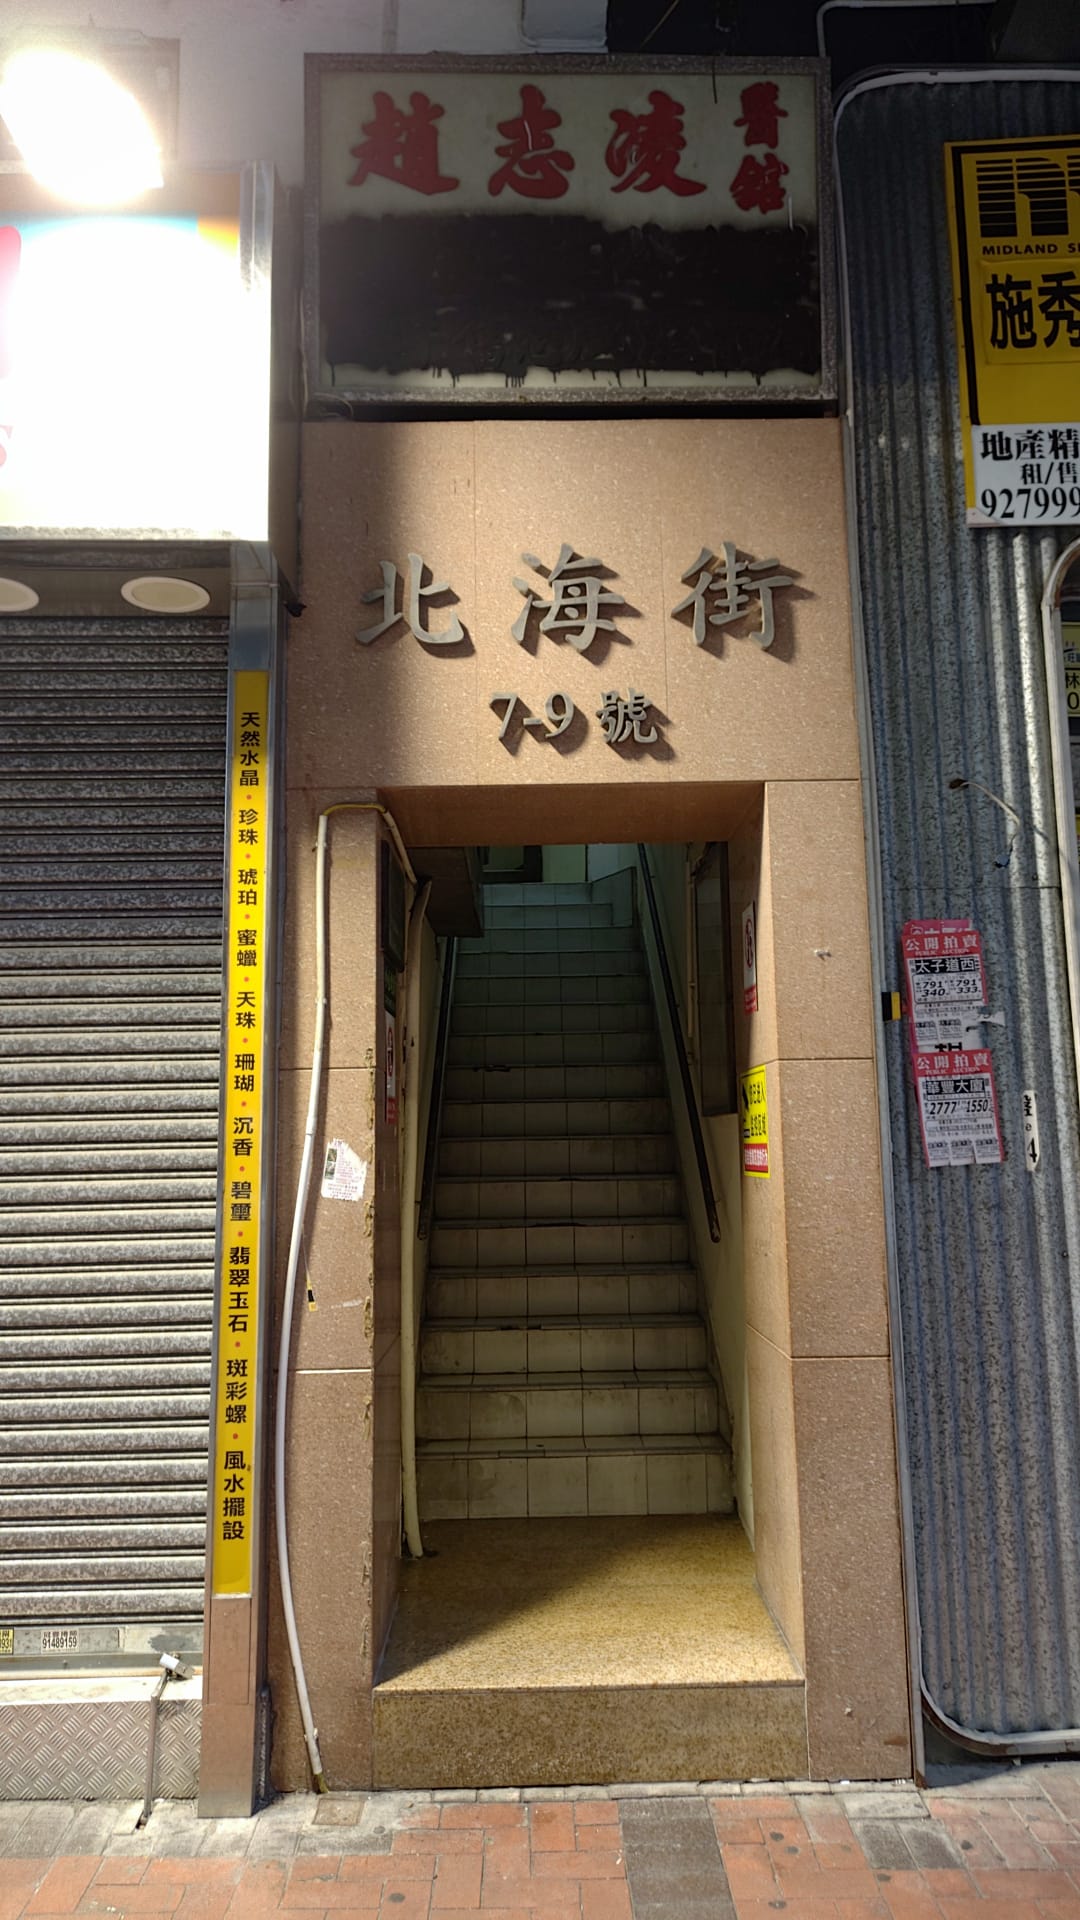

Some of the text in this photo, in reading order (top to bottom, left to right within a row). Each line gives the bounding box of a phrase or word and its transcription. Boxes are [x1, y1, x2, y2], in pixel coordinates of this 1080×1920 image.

[982, 243, 1058, 255] MIDLAND
[354, 541, 795, 651] 北海街
[905, 934, 978, 951] 公開拍賣
[916, 957, 976, 974] 太子道西
[922, 979, 977, 989] 791 791
[921, 988, 946, 997] 340
[917, 1053, 989, 1070] 公開拍賣
[930, 1099, 989, 1115] 2777 1550
[222, 712, 260, 1540] 天然水晶 珍珠 琥珀 蜜蠟 天珠 珊瑚 沉香 碧璽 翡翠玉石 斑彩螺 風水擺設
[42, 1636, 77, 1649] 91489159
